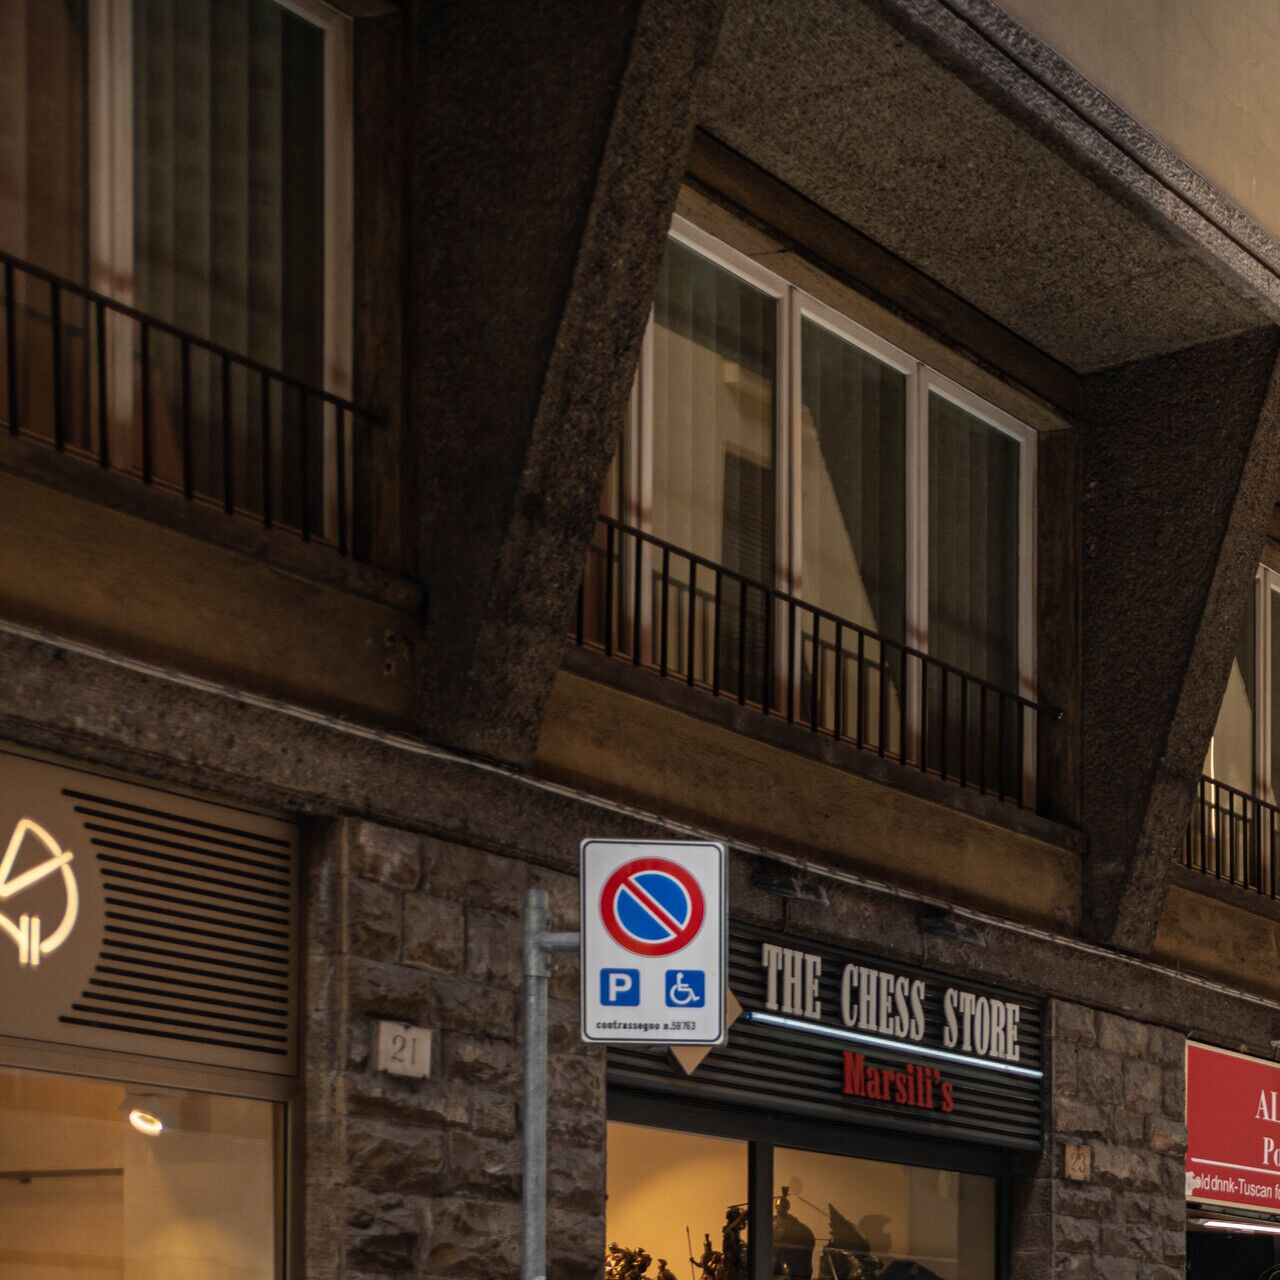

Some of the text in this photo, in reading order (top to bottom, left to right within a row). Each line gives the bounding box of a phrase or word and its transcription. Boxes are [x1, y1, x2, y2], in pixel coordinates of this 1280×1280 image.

[609, 973, 633, 1002] P
[762, 943, 1020, 1061] THE CHESS STORE
[596, 1020, 660, 1032] contrassegno
[392, 1034, 417, 1065] 21
[842, 1051, 955, 1113] Marsili's
